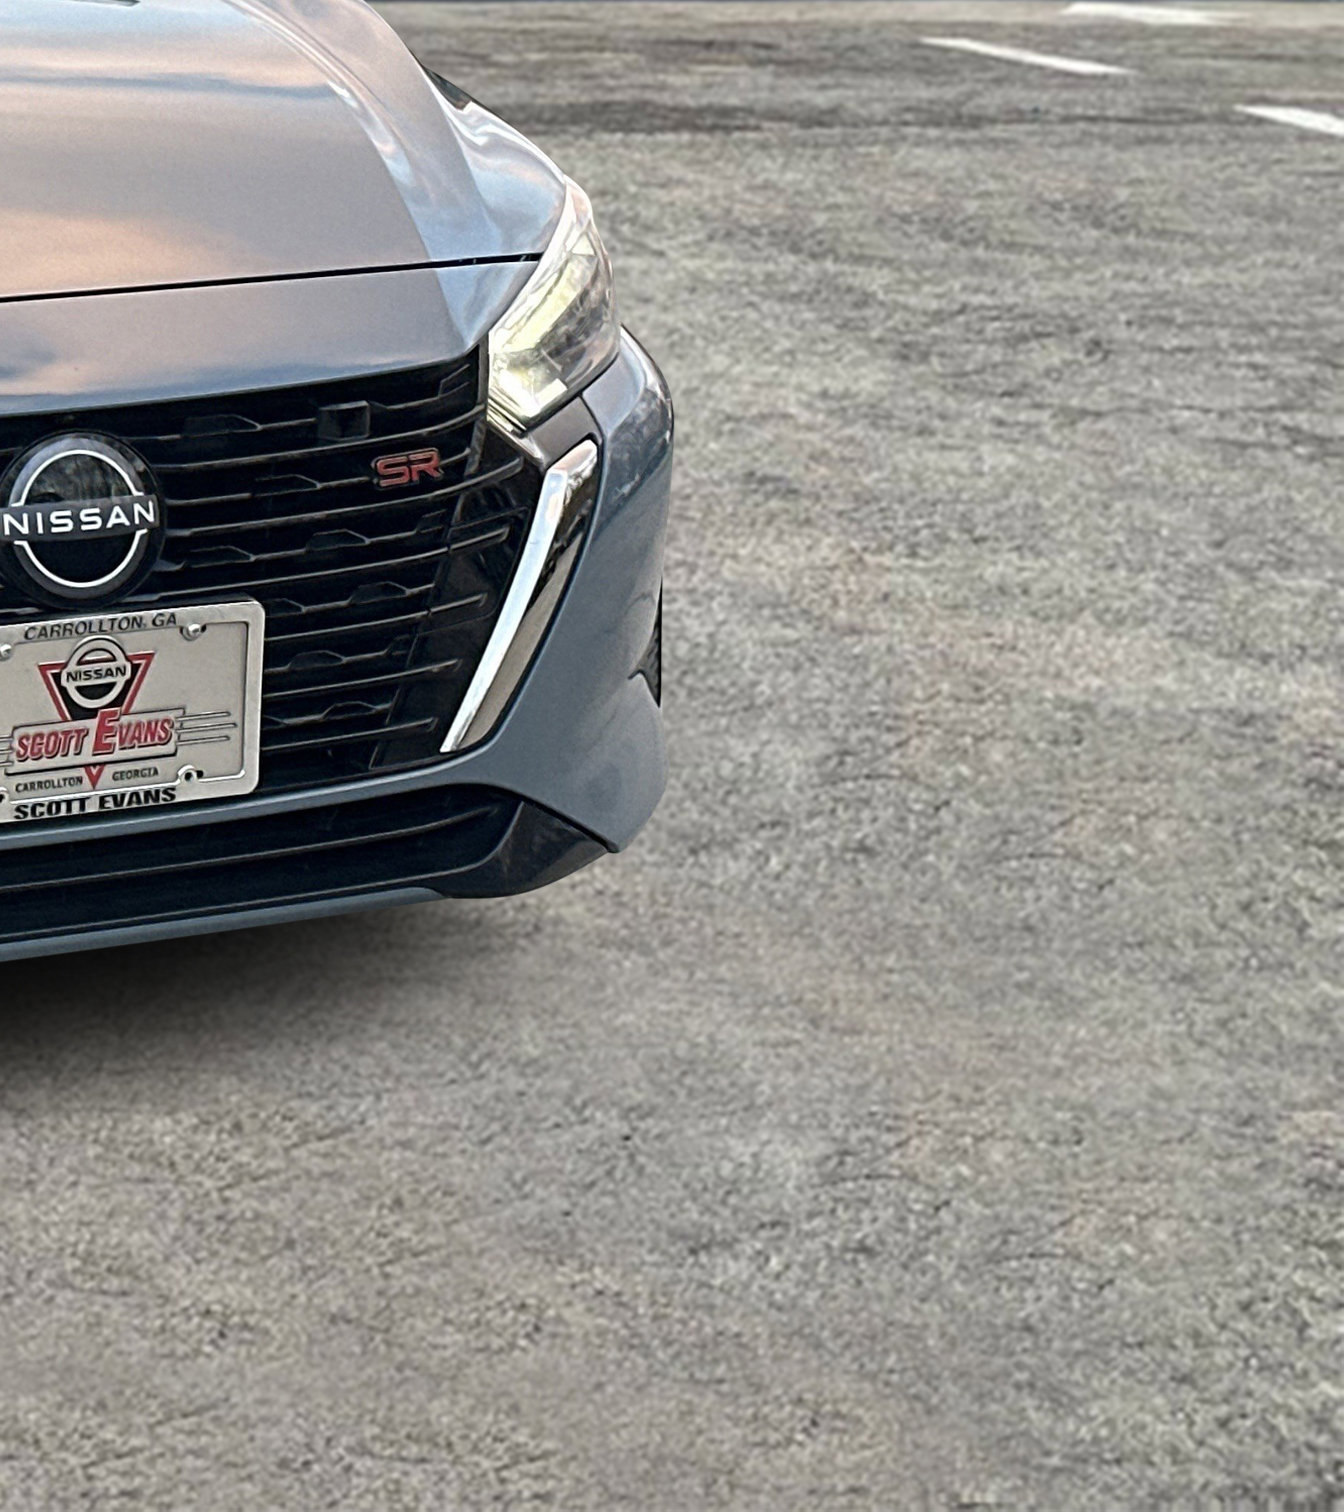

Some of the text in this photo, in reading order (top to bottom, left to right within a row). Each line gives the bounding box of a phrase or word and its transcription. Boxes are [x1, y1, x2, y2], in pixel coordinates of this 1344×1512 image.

[374, 447, 443, 487] SR
[2, 499, 156, 537] NISSAN
[152, 612, 177, 628] GA
[66, 665, 127, 683] NISSAN
[15, 707, 175, 763] SCOTT EVANS
[15, 766, 159, 793] CARROLLTON GEORGIA
[14, 787, 177, 820] SCOTT EVANS
